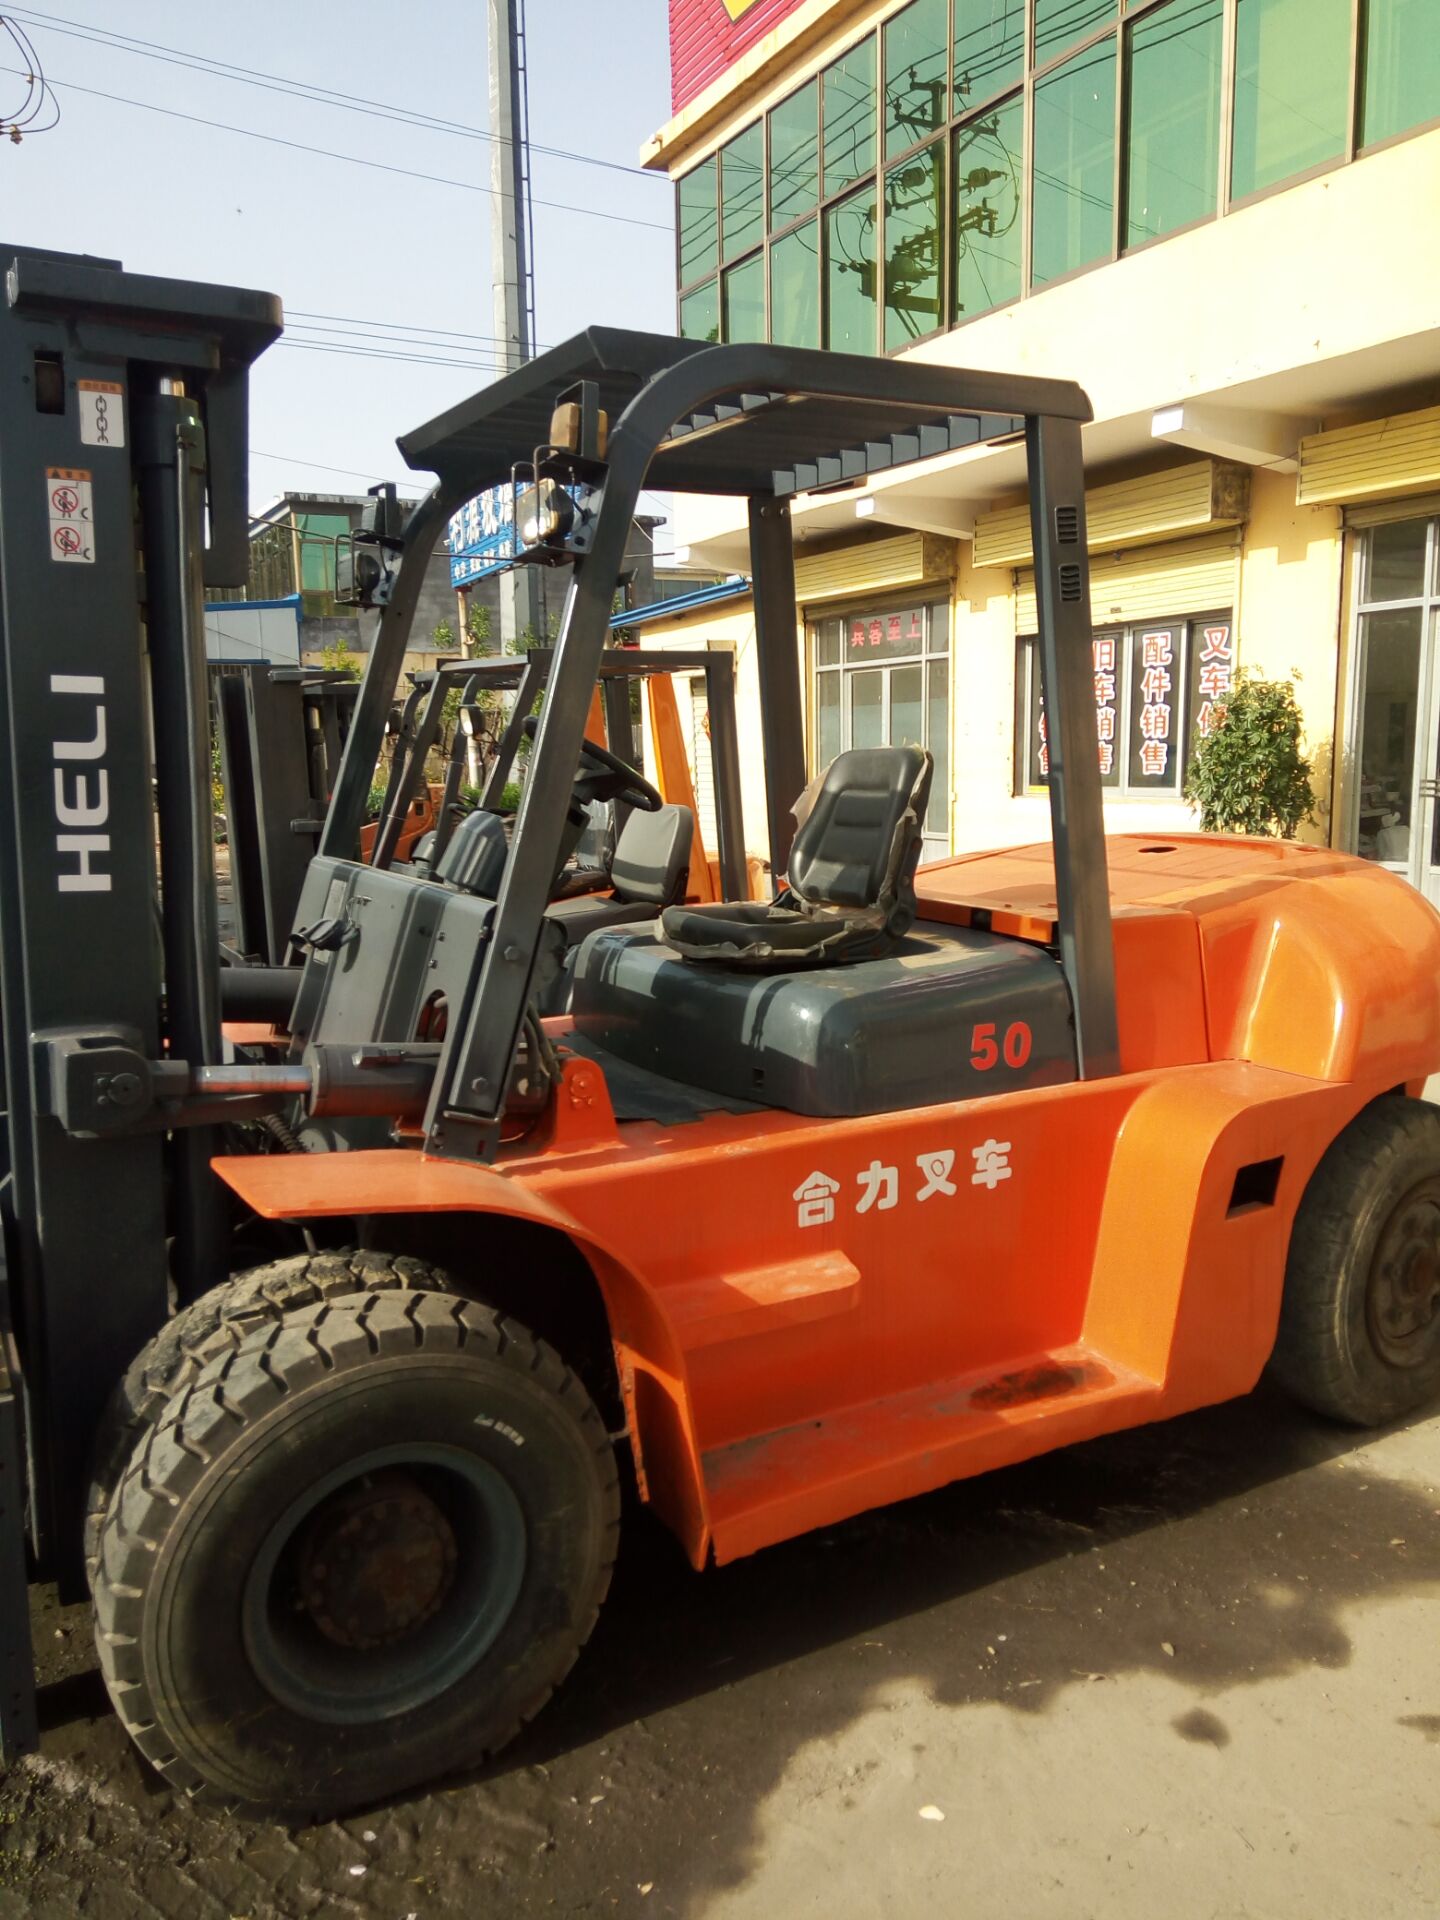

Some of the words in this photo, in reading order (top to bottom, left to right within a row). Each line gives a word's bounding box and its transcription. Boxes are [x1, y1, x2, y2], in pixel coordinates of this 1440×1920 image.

[1139, 631, 1172, 775] 配件销售
[50, 674, 113, 893] HELI
[970, 1021, 1032, 1071] 50
[792, 1138, 1012, 1228] 合力叉车
